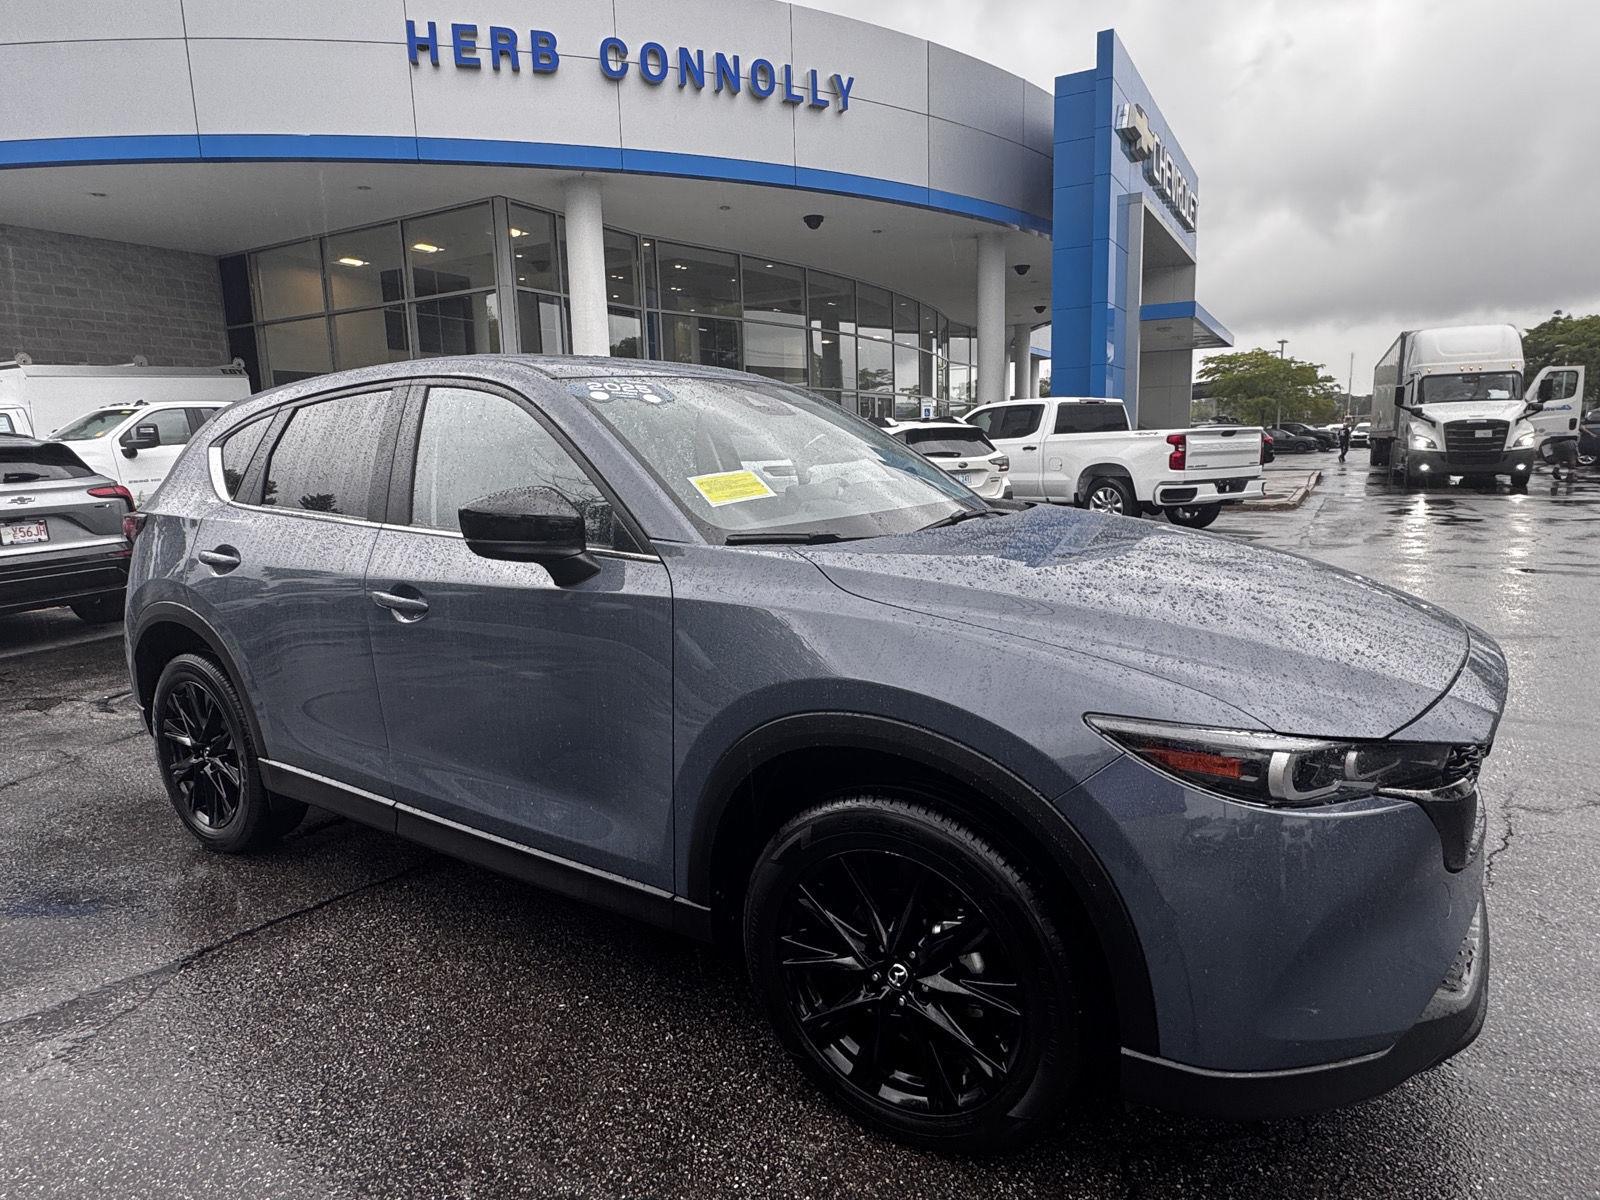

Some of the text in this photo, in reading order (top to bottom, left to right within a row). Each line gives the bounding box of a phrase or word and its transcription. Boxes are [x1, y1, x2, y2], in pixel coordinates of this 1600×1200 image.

[406, 20, 855, 113] HERB CONNOLLY
[586, 381, 653, 394] 2025
